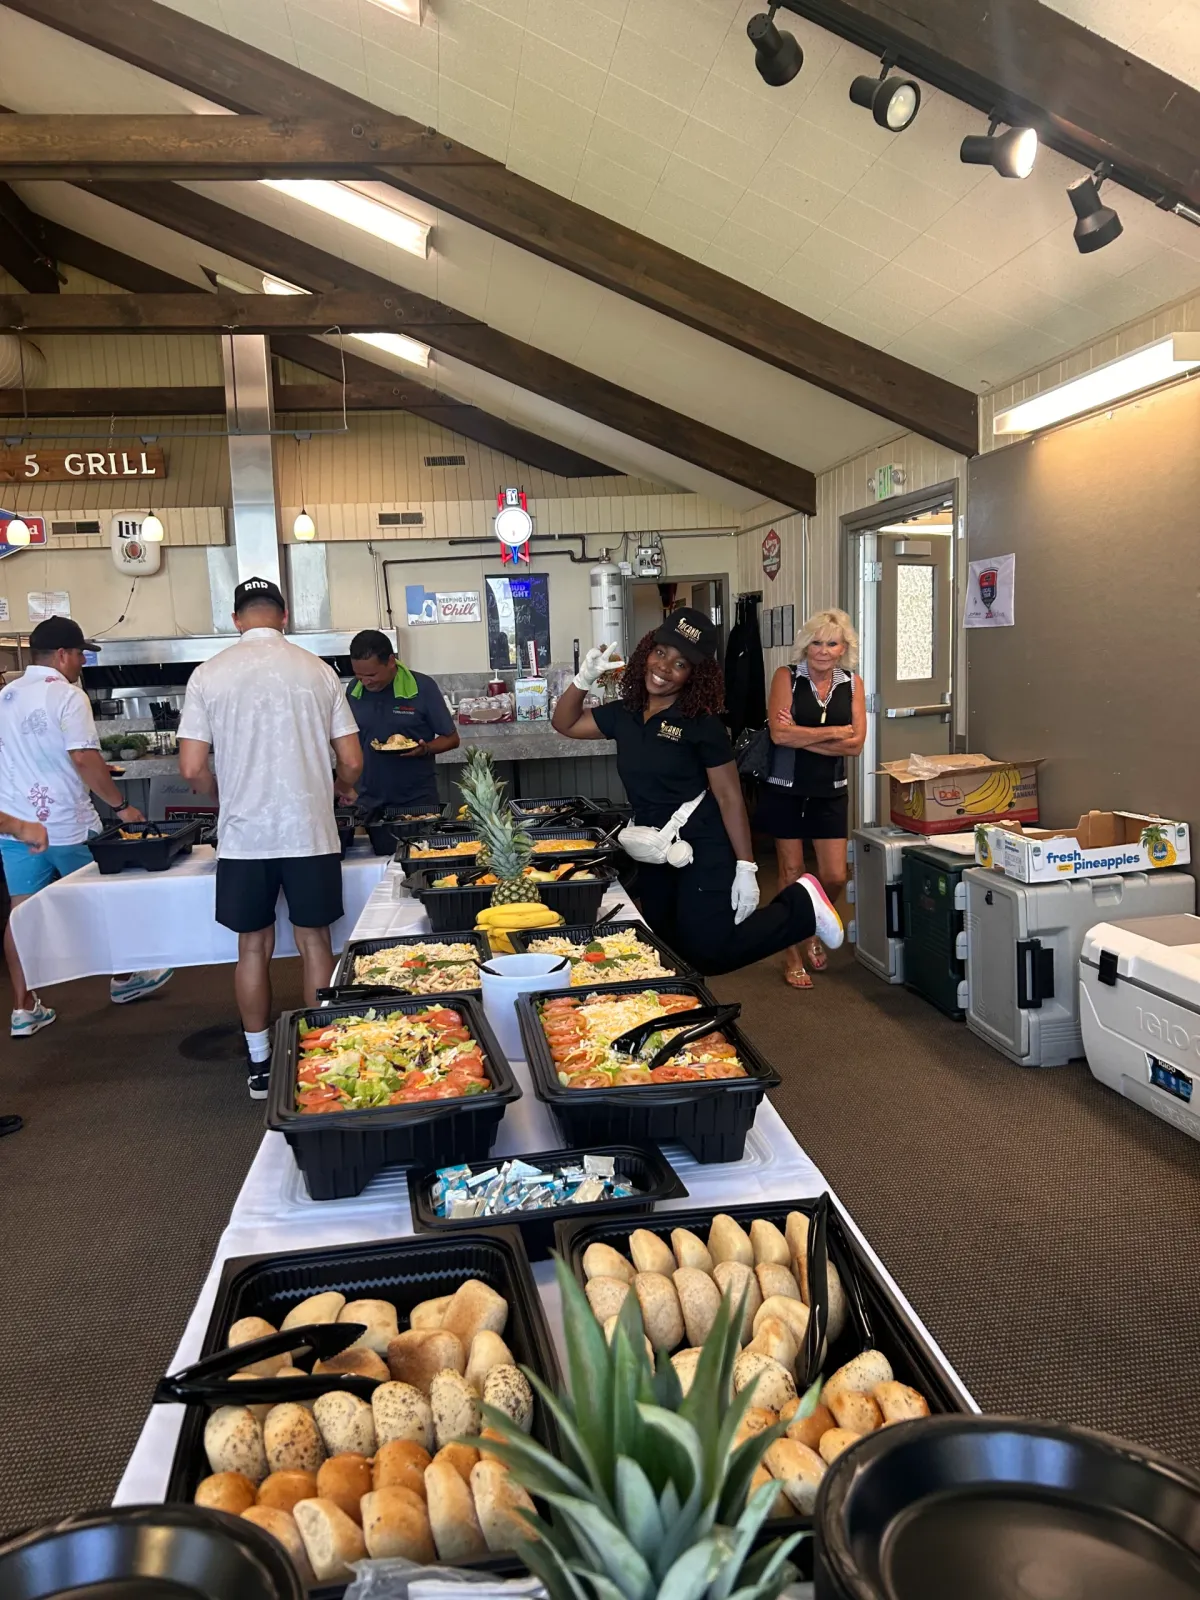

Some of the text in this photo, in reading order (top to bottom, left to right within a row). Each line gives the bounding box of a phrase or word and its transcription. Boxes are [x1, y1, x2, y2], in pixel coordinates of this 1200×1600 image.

[24, 452, 156, 477] 5 GRILL
[117, 521, 143, 539] Lit
[442, 603, 476, 616] Chill
[939, 788, 960, 799] Dole
[1046, 849, 1081, 864] fresh
[1074, 853, 1140, 874] pineapples
